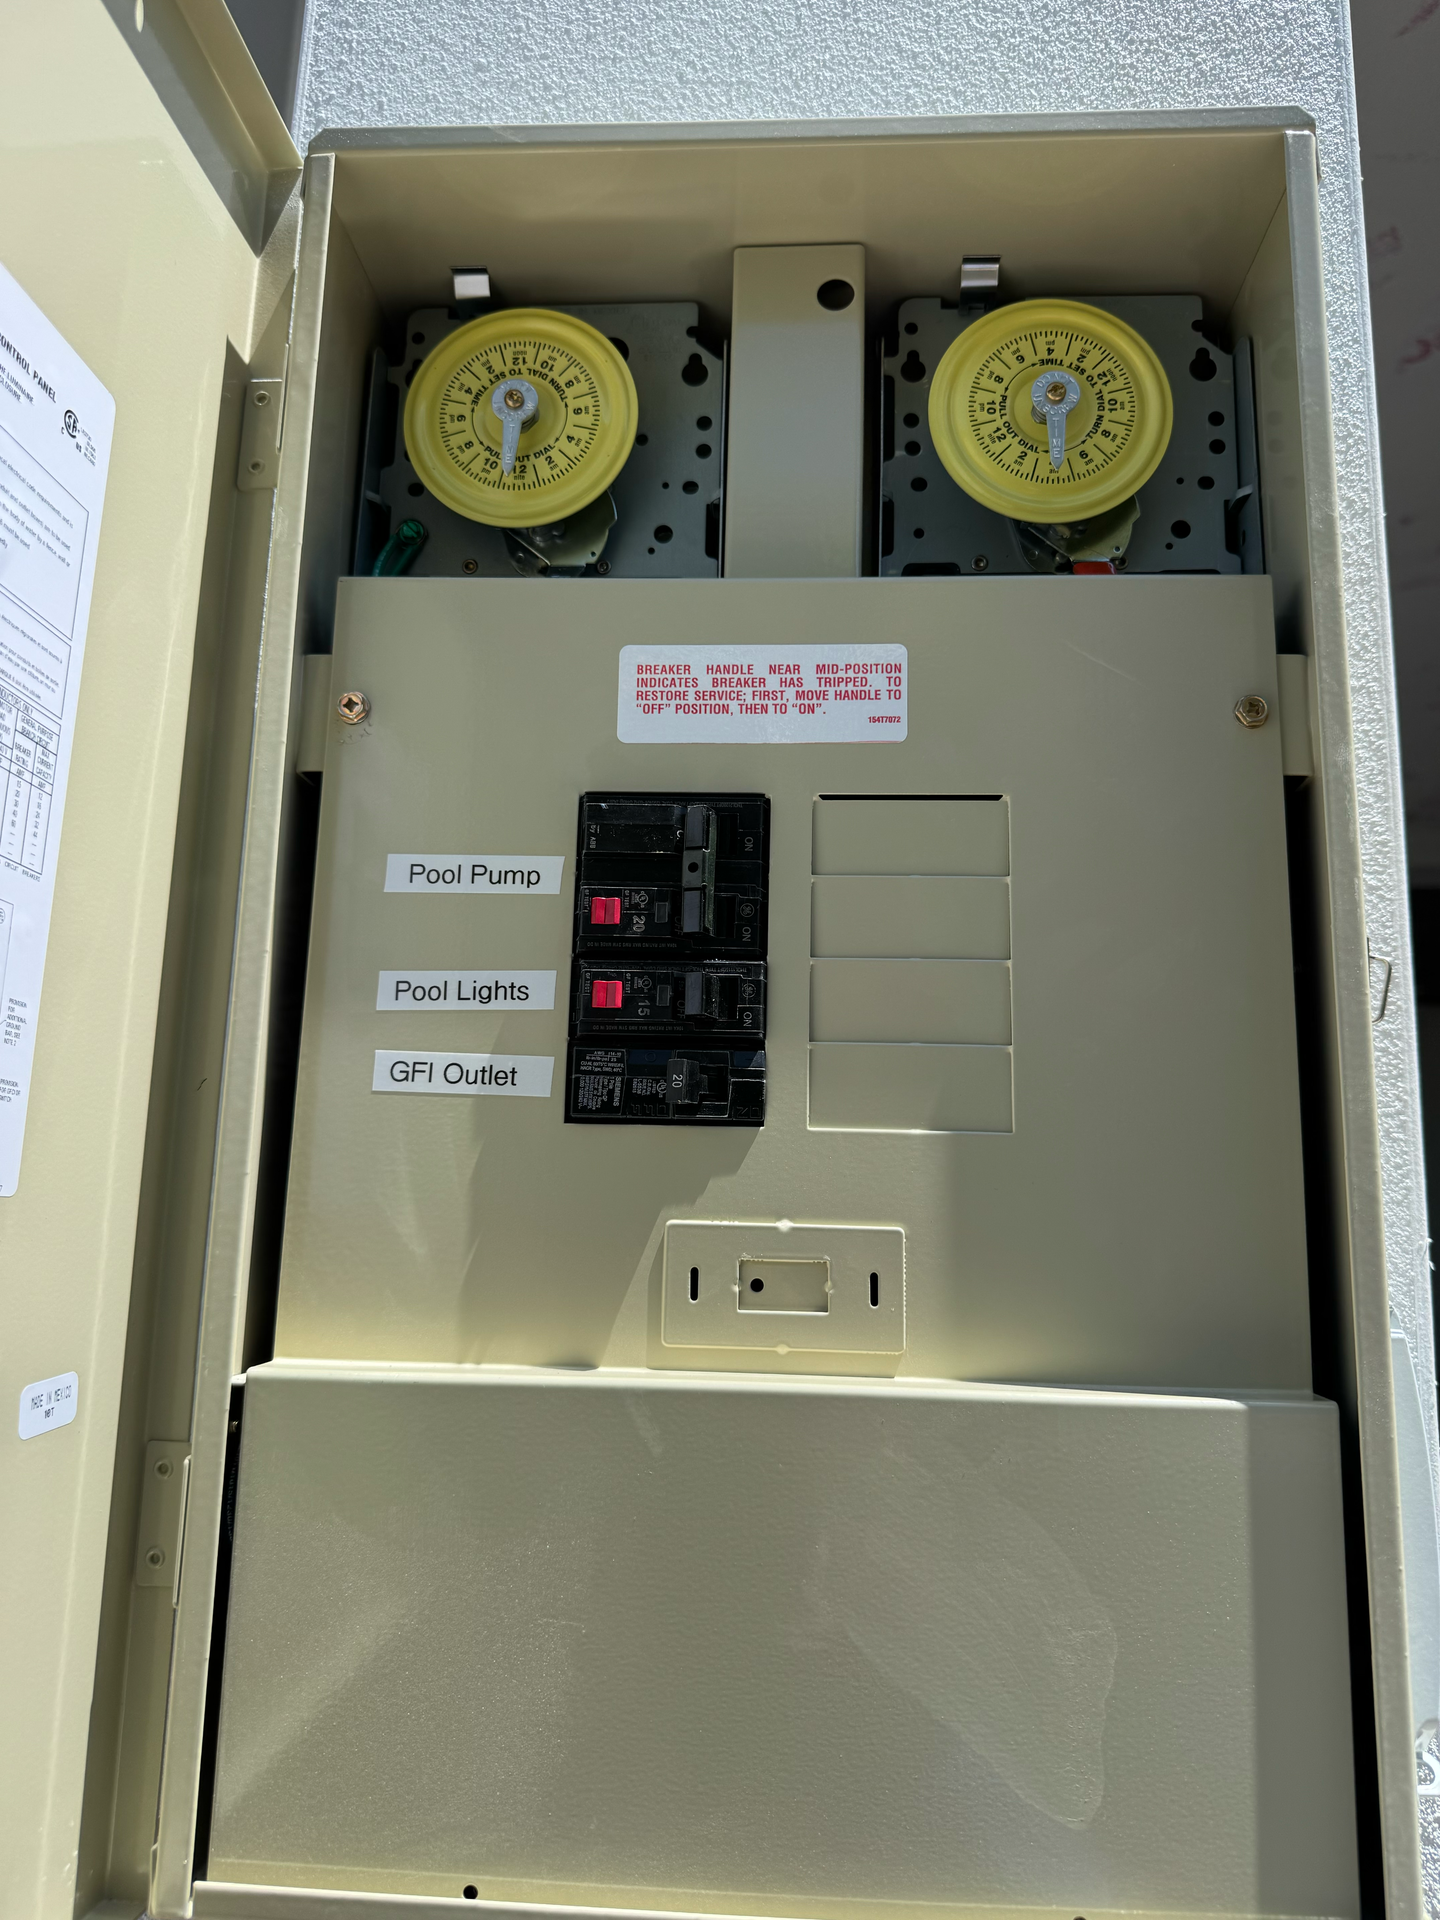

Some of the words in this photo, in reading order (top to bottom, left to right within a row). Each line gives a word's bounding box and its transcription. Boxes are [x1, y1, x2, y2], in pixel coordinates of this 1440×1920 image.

[1015, 354, 1026, 364] 6
[1046, 347, 1055, 356] 4
[1077, 353, 1087, 364] 2
[512, 356, 528, 366] 12
[540, 360, 555, 373] 10
[1038, 358, 1065, 367] TIME
[1066, 360, 1087, 377] SET
[486, 364, 496, 375] 2
[509, 368, 523, 377] TO
[527, 367, 549, 382] DIAL
[33, 370, 56, 403] PANEL
[489, 371, 507, 388] SET
[565, 379, 575, 389] 8
[994, 375, 1004, 384] 8
[1085, 374, 1098, 389] TO
[1097, 371, 1112, 387] 12
[463, 386, 474, 396] 4
[470, 384, 489, 408] TIME
[548, 378, 569, 403] TURN
[986, 400, 997, 415] 10
[998, 394, 1008, 420] PULL
[1094, 388, 1106, 415] DIAL
[1108, 398, 1118, 414] 10
[457, 414, 467, 423] 6
[573, 407, 583, 416] 6
[992, 426, 1007, 443] 12
[1002, 420, 1020, 440] OUT
[1085, 414, 1105, 440] TURN
[1101, 429, 1112, 439] 8
[464, 440, 475, 450] 8
[505, 424, 515, 464] TIME
[566, 434, 576, 444] 4
[1053, 417, 1062, 458] TIME
[483, 445, 502, 460] PUL
[533, 443, 556, 460] DIAL
[1017, 438, 1040, 455] DIAL
[545, 455, 556, 466] 2
[1018, 451, 1028, 461] 2
[1079, 450, 1089, 460] 6
[483, 457, 499, 470] 10
[636, 664, 691, 675] BREAKER
[706, 664, 754, 675] HANDLE
[768, 664, 801, 675] NEAR
[815, 663, 902, 674] MID-POSITION
[636, 677, 699, 688] INDICATES
[711, 677, 766, 688] BREAKER
[779, 677, 804, 688] HAS
[816, 677, 873, 688] TRIPPED.
[886, 676, 902, 687] TO
[636, 690, 689, 701] RESTORE
[694, 690, 746, 703] SERVICE;
[752, 690, 789, 702] FIRST,
[795, 690, 829, 701] MOVE
[834, 689, 882, 700] HANDLE
[886, 689, 902, 700] TO
[675, 703, 734, 716] POSITION,
[738, 703, 768, 714] THEN
[774, 703, 788, 714] TO
[744, 837, 754, 851] ON
[409, 864, 462, 884] Pool
[471, 864, 541, 888] Pump
[632, 915, 646, 932] 20
[742, 927, 751, 942] ON
[395, 980, 448, 1001] Pool
[457, 980, 530, 1004] Lights
[638, 1000, 650, 1016] 15
[676, 1000, 686, 1019] OFF
[743, 1012, 752, 1027] ON
[390, 1060, 433, 1083] GFI
[443, 1062, 518, 1087] Outlet
[672, 1074, 683, 1088] 20
[614, 1077, 622, 1107] SIEMENS
